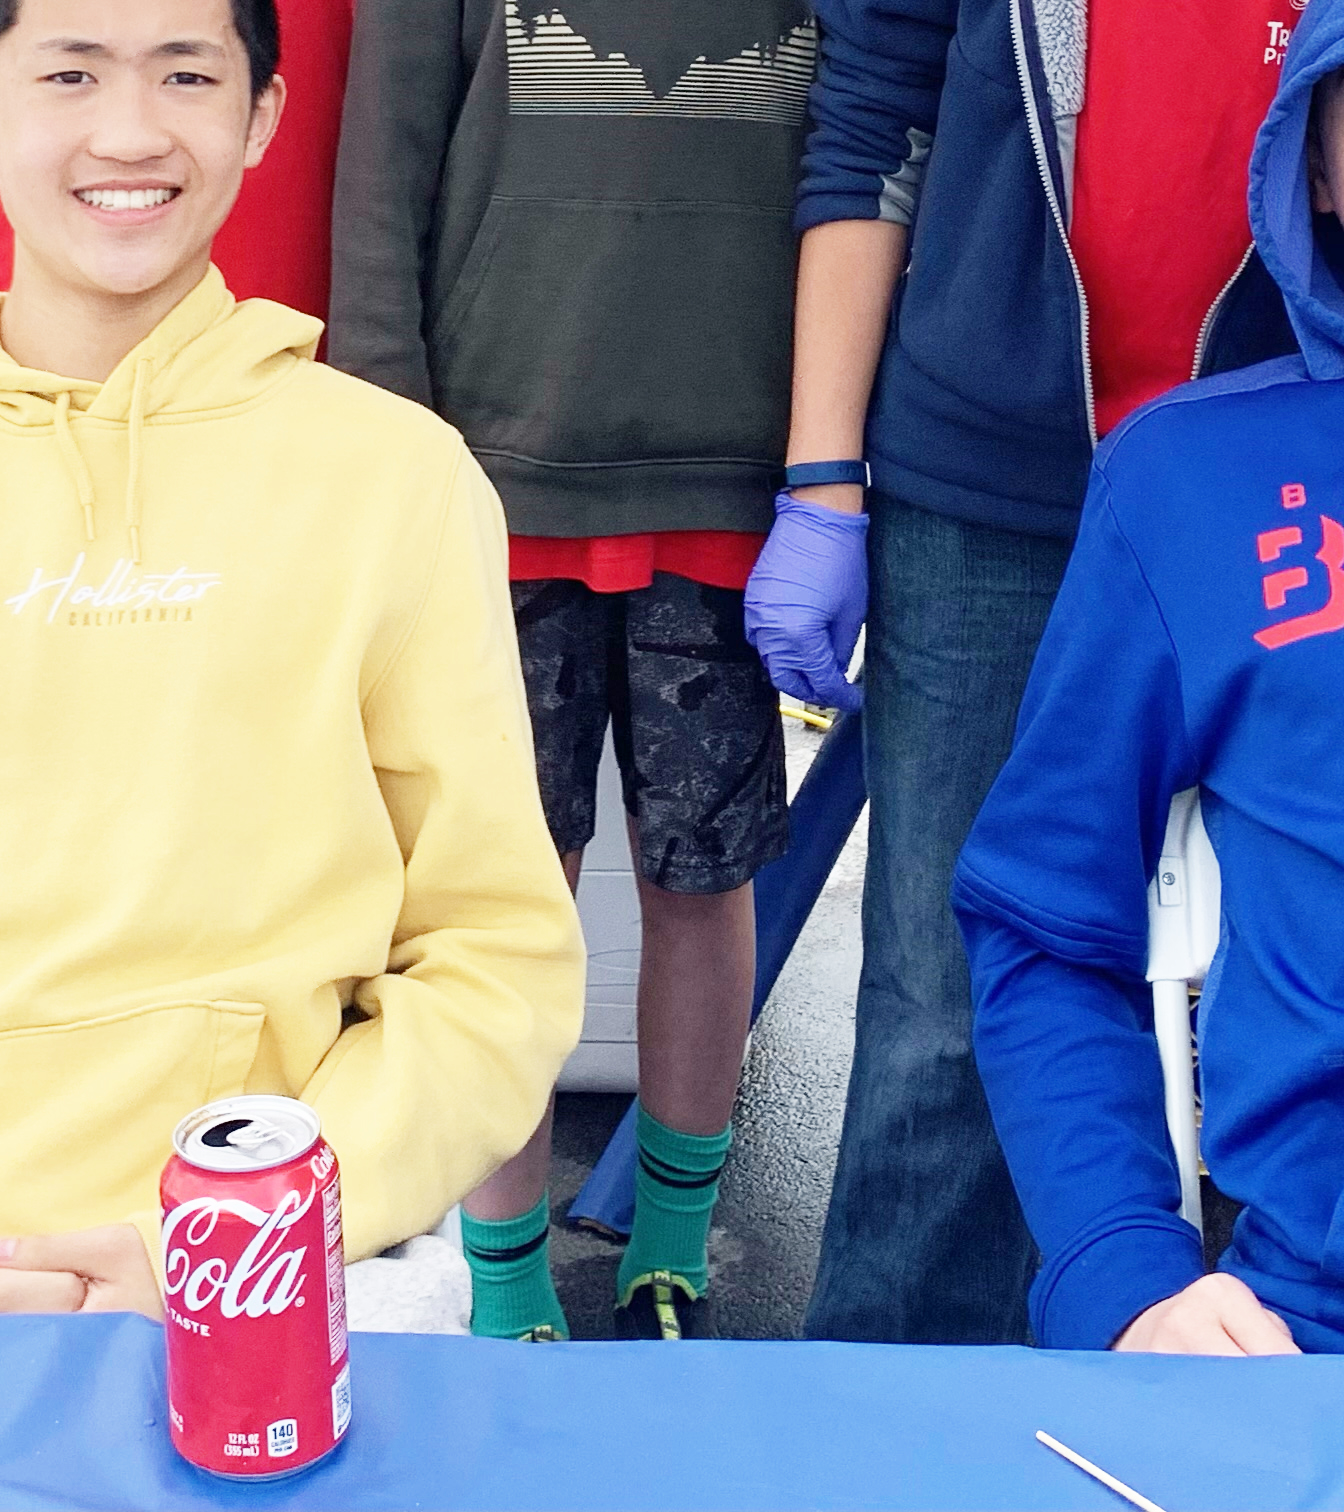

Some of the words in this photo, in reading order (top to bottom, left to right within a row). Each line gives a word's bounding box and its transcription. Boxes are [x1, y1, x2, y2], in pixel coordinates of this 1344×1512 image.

[4, 550, 224, 625] Hollister
[68, 606, 194, 627] CALIFORNIA
[170, 1309, 211, 1337] TASTE
[228, 1433, 238, 1445] 12
[272, 1423, 294, 1440] 140
